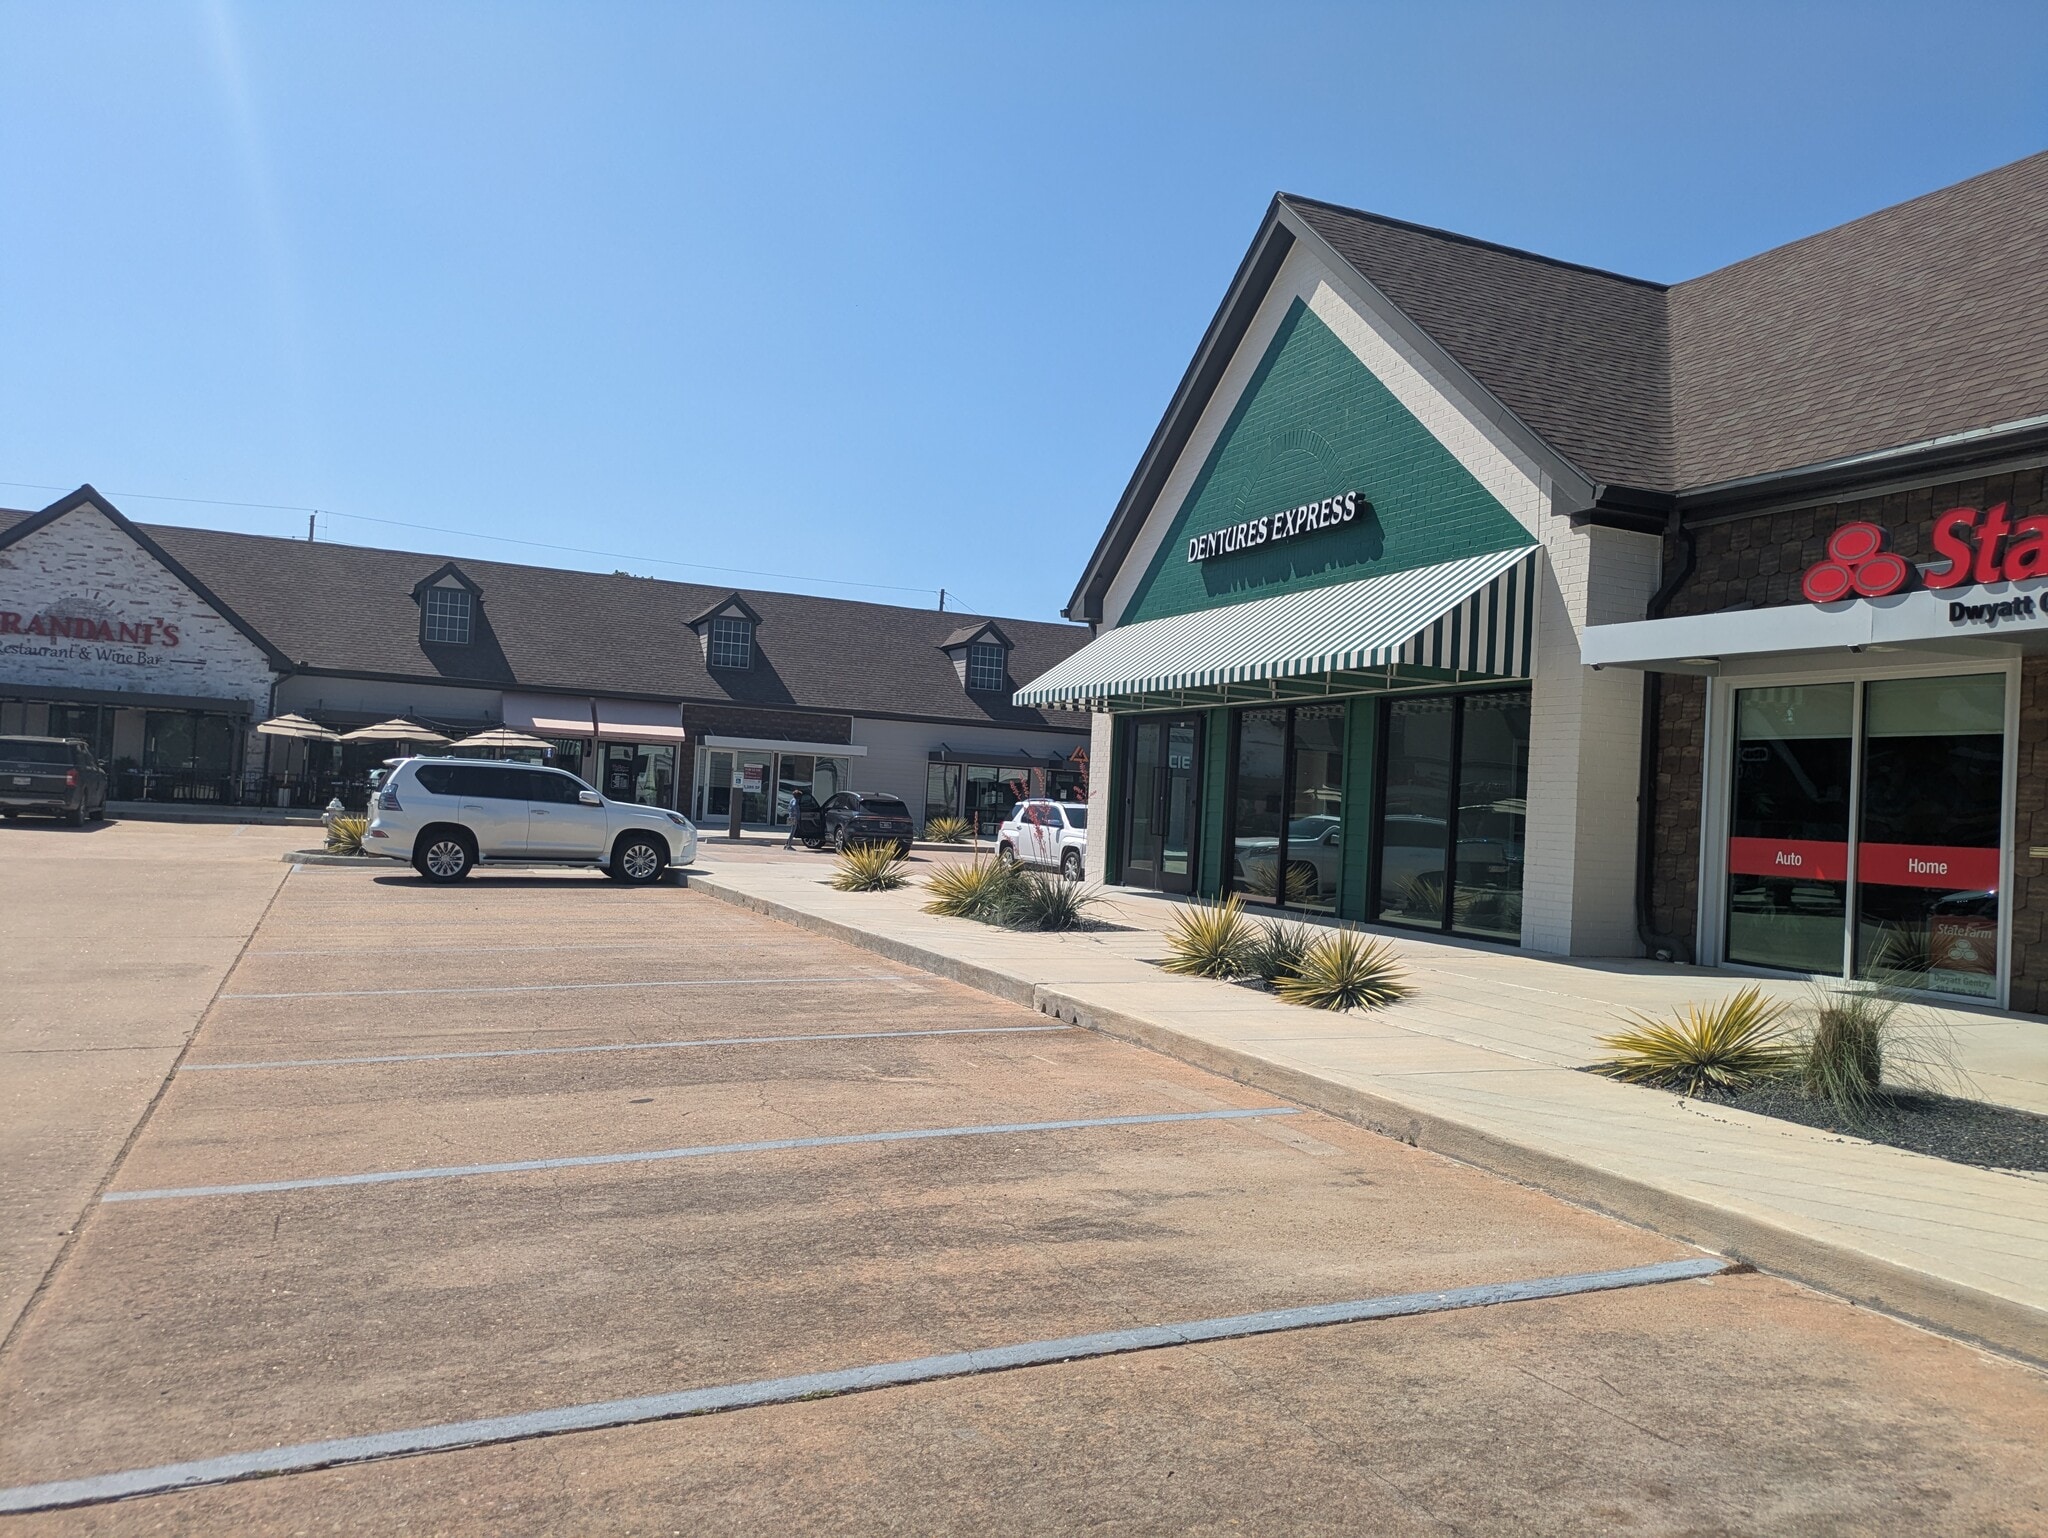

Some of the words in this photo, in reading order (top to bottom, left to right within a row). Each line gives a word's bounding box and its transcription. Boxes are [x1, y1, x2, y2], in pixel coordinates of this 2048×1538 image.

[1187, 516, 1269, 563] DENTURES
[1271, 490, 1357, 541] EXPRESS
[1923, 501, 2048, 589] Sta
[1949, 595, 2033, 624] Dwyatt
[0, 611, 180, 647] RANDANI'S
[78, 646, 91, 661] &
[96, 647, 133, 664] Wine
[137, 651, 163, 665] Bar
[1775, 850, 1802, 867] Auto
[1908, 858, 1948, 875] Home
[1963, 977, 1991, 990] Gentry
